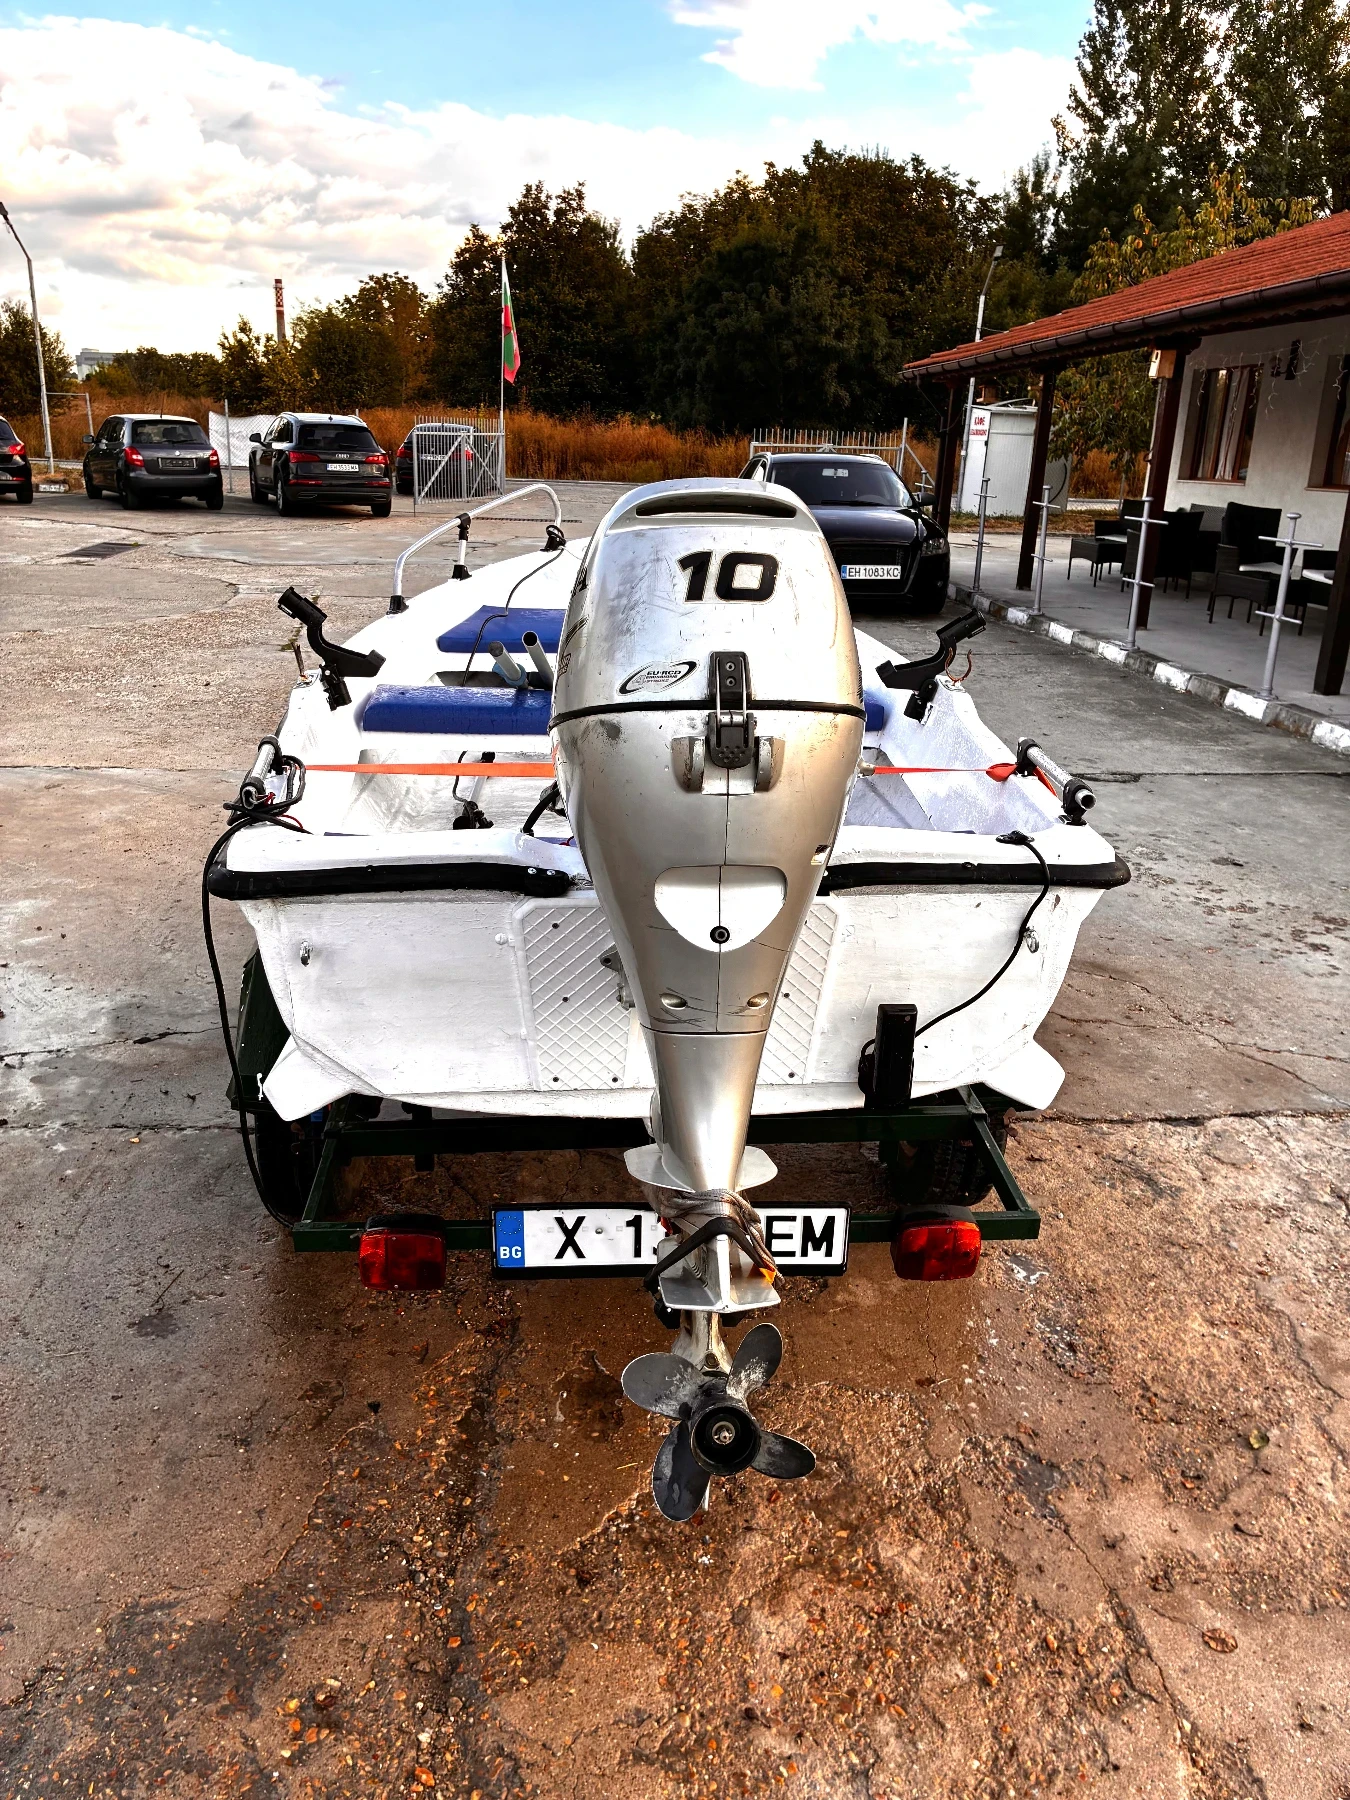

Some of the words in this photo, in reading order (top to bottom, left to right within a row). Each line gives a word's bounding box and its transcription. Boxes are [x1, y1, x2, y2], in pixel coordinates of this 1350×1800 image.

[676, 550, 779, 603] 10
[848, 567, 861, 577] EH
[863, 567, 885, 578] 1083
[886, 567, 899, 578] KC
[554, 1215, 587, 1259] X
[764, 1215, 836, 1258] EM
[499, 1245, 522, 1259] BG
